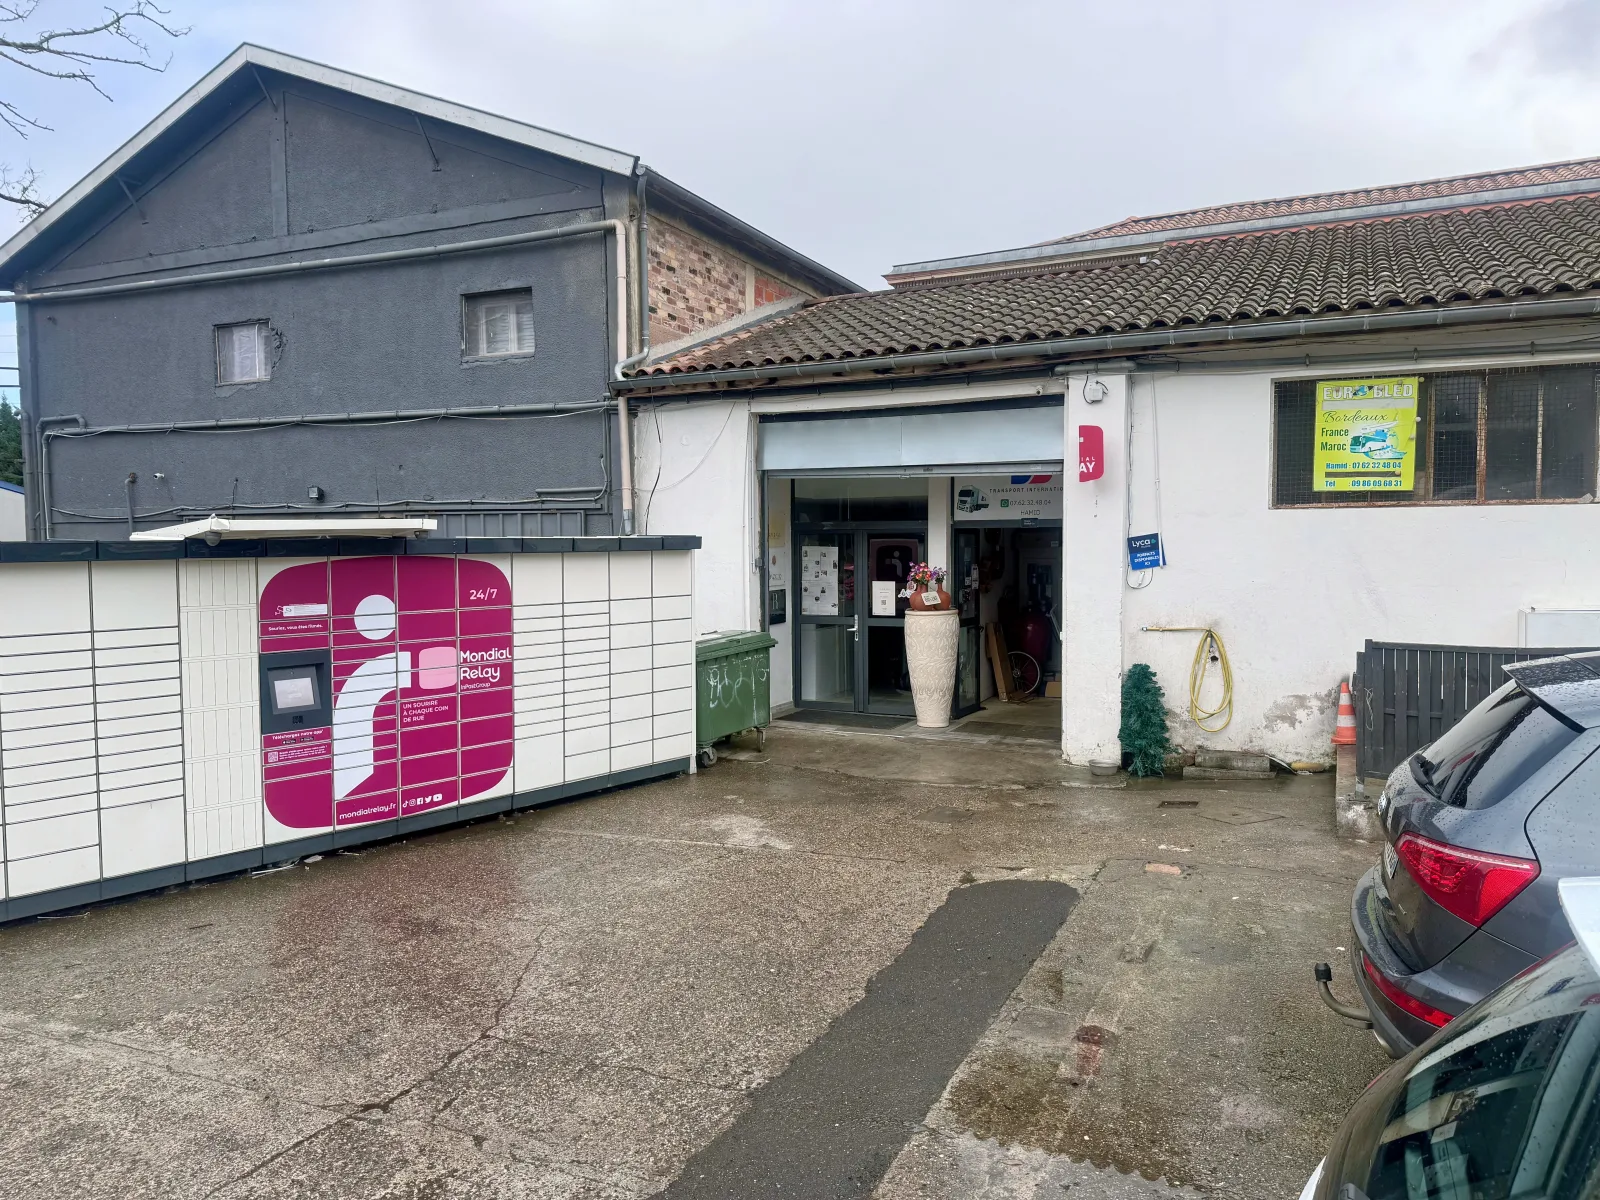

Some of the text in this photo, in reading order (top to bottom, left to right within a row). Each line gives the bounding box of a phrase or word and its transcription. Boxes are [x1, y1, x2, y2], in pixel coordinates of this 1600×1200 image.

[1373, 384, 1414, 399] BLED
[1322, 410, 1389, 423] Bordeaux
[1321, 427, 1349, 437] France
[1320, 442, 1347, 451] Maroc
[1382, 461, 1391, 469] 48
[1392, 461, 1402, 469] 04
[1131, 539, 1151, 548] Lyca
[469, 587, 498, 600] 24/7
[460, 646, 512, 662] Mondial
[460, 665, 500, 682] Relay
[412, 699, 439, 708] SOURIRE
[408, 706, 434, 715] CHAQUE
[434, 704, 449, 712] COIN
[412, 714, 425, 722] RUE
[339, 802, 397, 820] mondialrelay.fr
